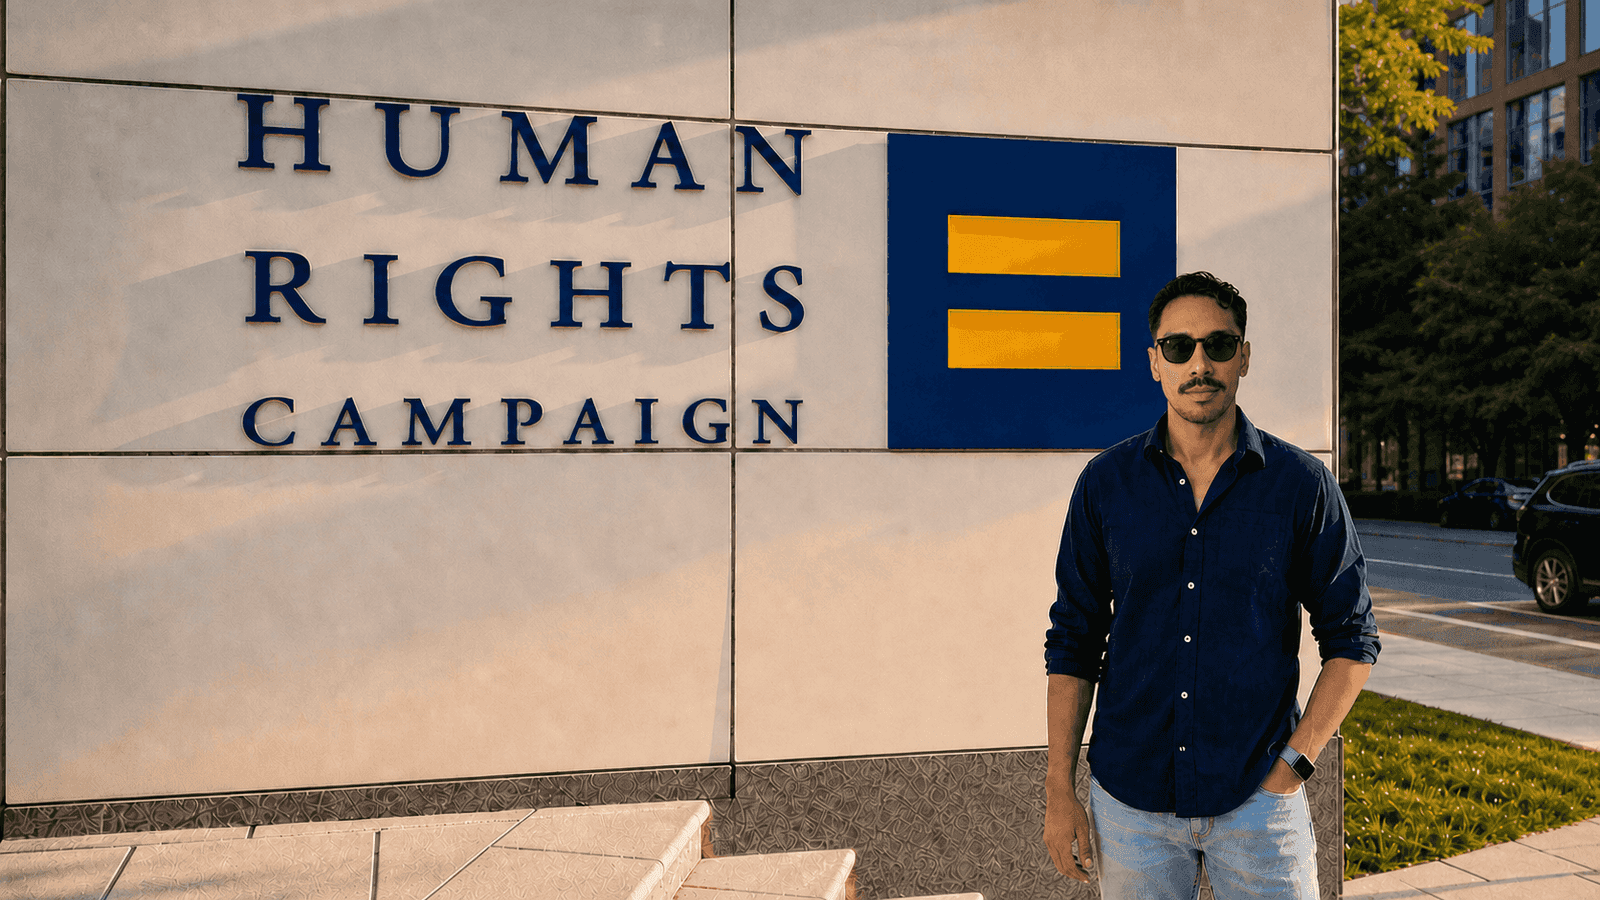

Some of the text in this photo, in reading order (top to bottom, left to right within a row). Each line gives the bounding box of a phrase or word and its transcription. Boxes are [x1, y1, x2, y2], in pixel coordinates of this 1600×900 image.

[237, 93, 812, 196] HUMAN
[244, 250, 806, 333] RIGHTS
[241, 396, 803, 447] CAMPAIGN
